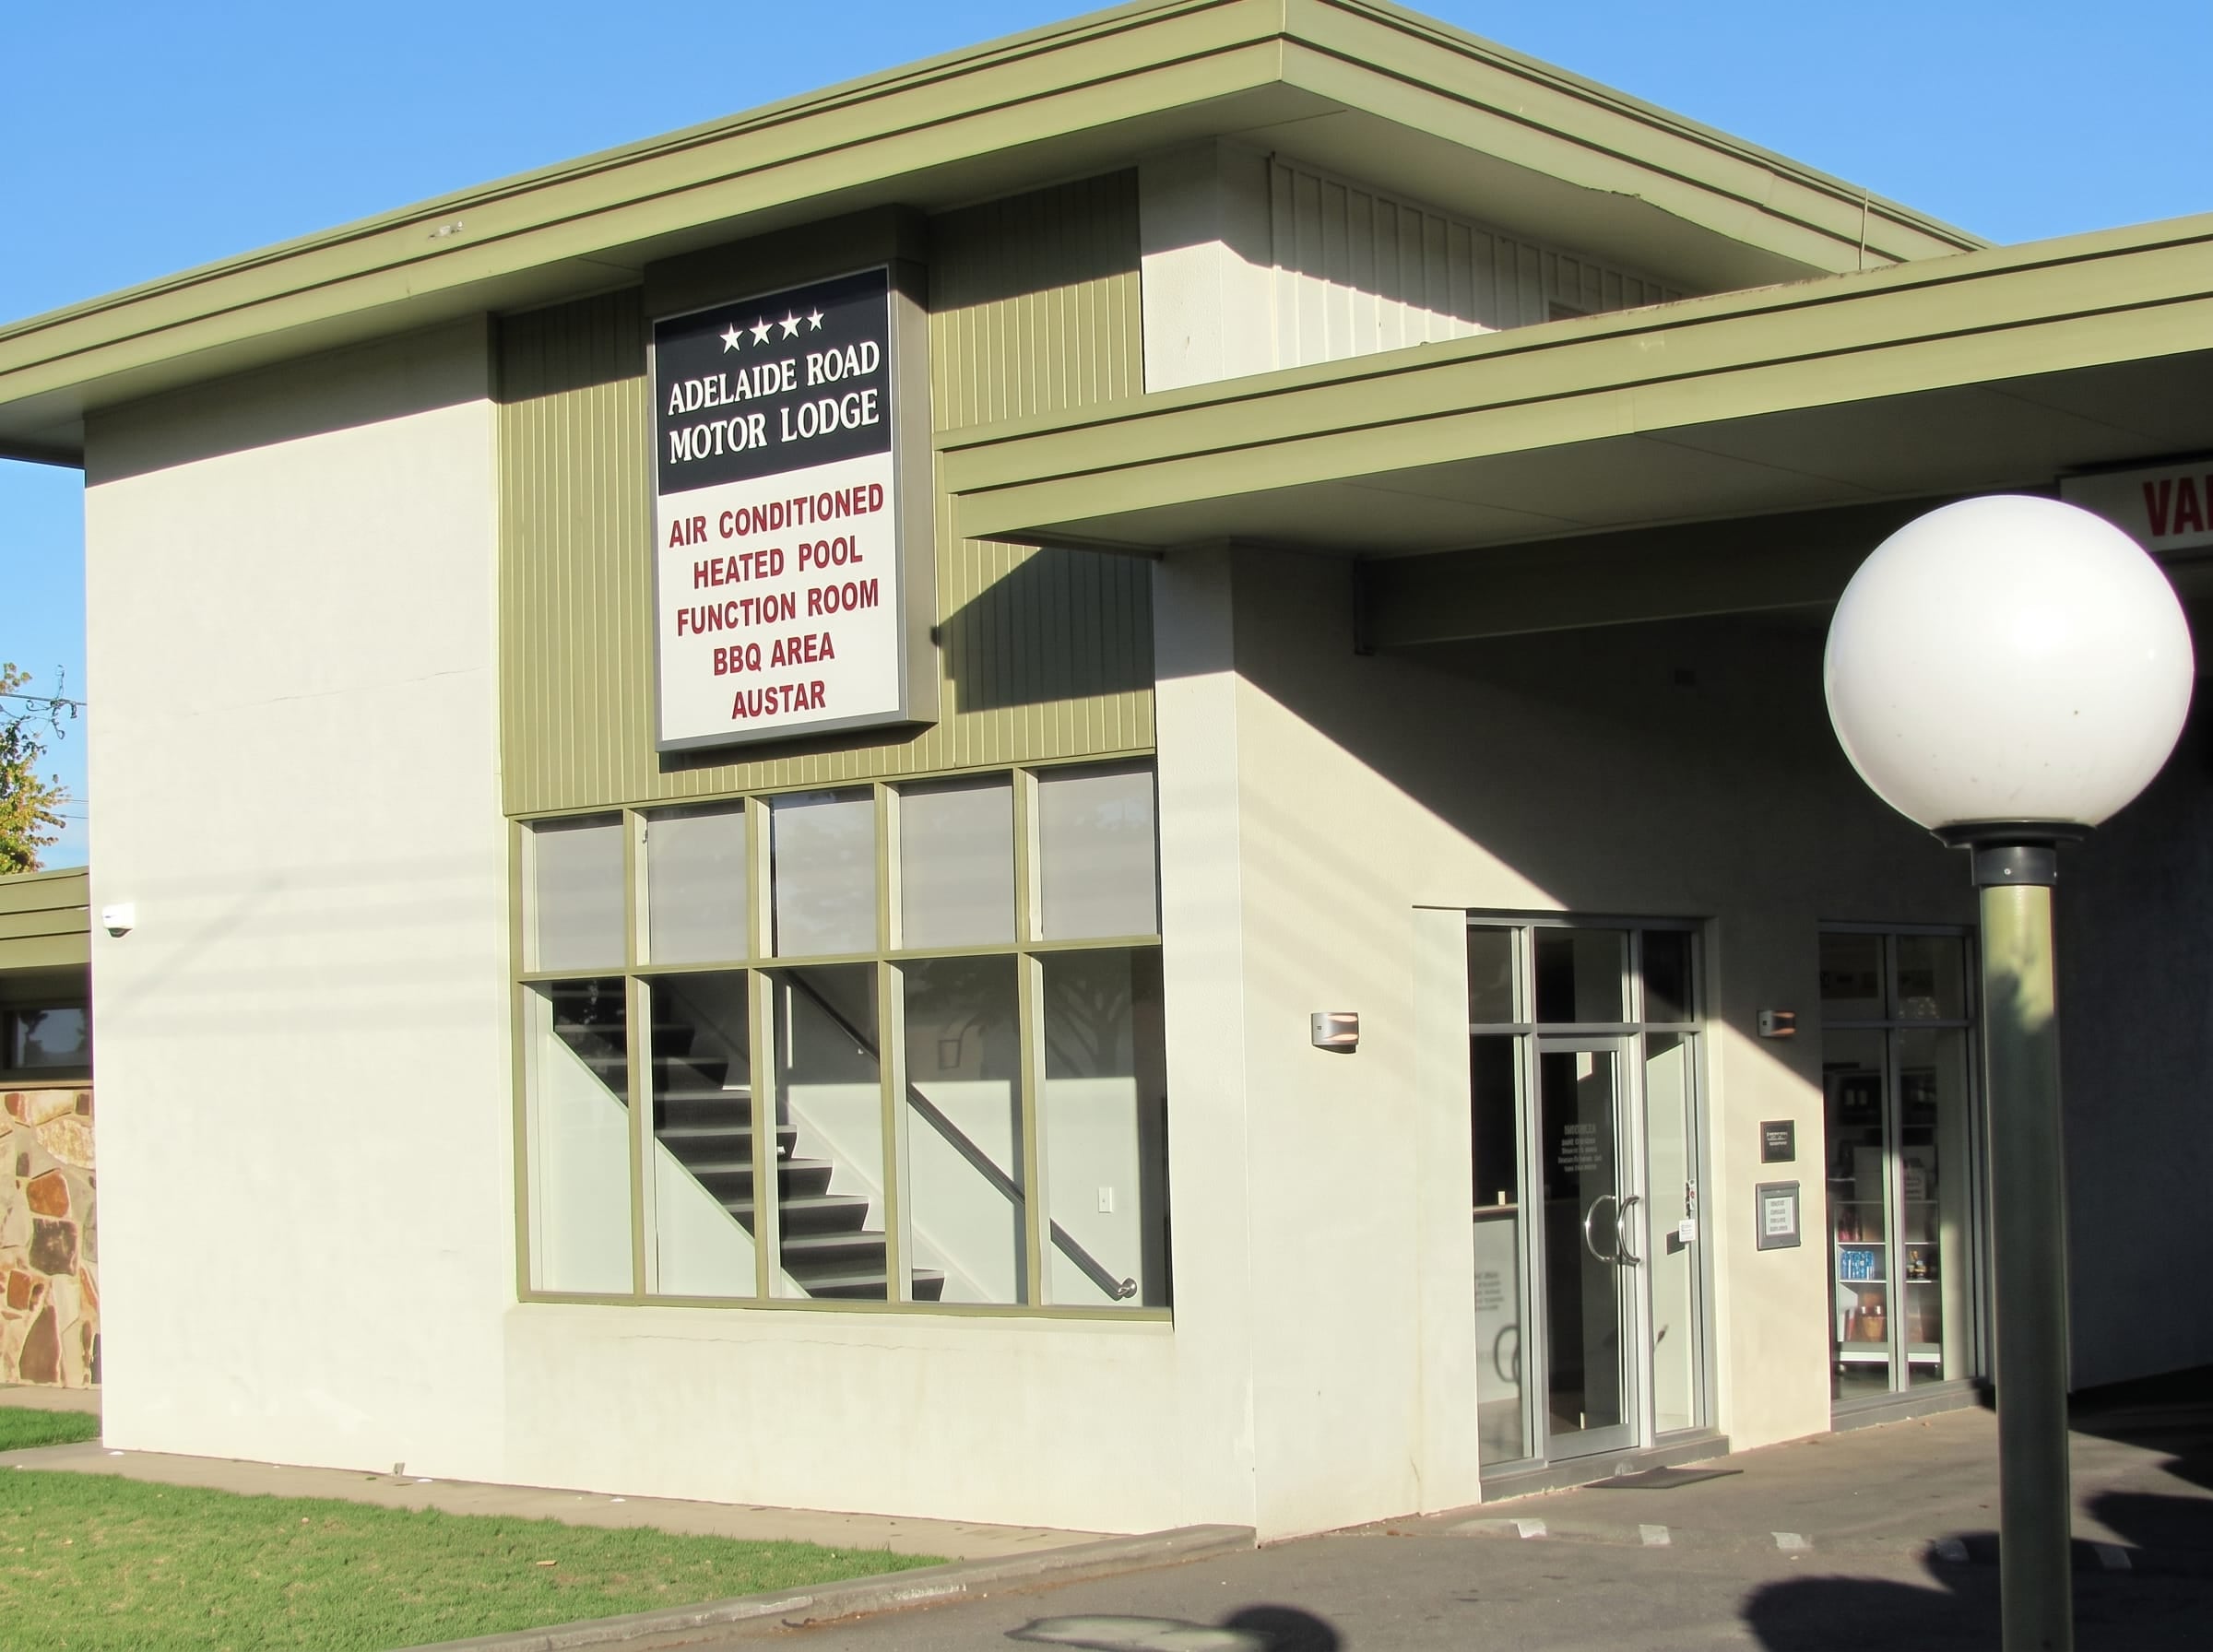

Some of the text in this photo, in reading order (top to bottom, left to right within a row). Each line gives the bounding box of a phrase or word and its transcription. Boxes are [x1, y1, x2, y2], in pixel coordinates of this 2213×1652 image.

[669, 340, 881, 416] ADELAIDE ROAD
[669, 388, 880, 464] MOTOR LODGE
[669, 483, 884, 548] AIR CONDITIONED
[693, 536, 863, 589] HEATED POOL
[677, 579, 879, 636] FUNCTION ROOM
[714, 632, 834, 676] BBQ AREA
[731, 680, 826, 719] AUSTAR
